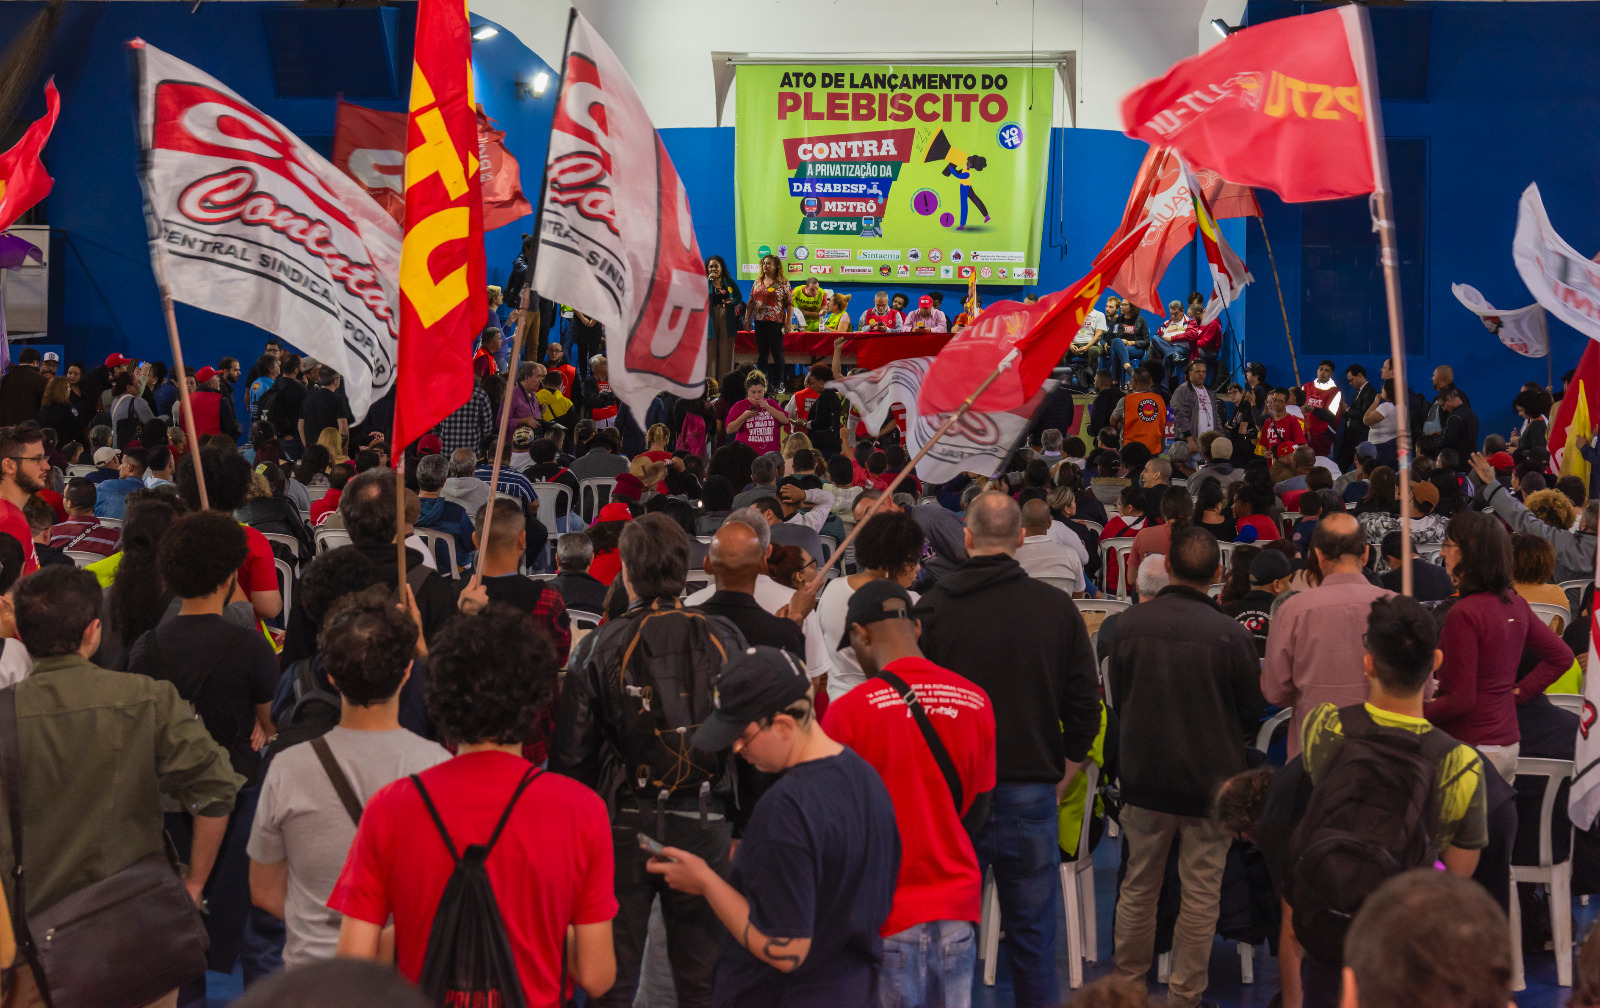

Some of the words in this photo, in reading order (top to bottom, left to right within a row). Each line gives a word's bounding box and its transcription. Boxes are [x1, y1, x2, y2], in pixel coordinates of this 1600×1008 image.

[780, 72, 817, 89] ATO
[821, 72, 845, 89] DE
[850, 73, 977, 92] LANÇAMENTO
[981, 74, 1008, 90] DO
[777, 91, 1009, 122] PLEBISCITO
[1001, 127, 1019, 140] VO
[1004, 135, 1021, 148] TE
[797, 138, 898, 160] CONTRA
[807, 164, 814, 176] A
[815, 163, 878, 178] PRIVATIZAÇÃO
[879, 165, 892, 177] DA
[793, 182, 812, 194] DA
[815, 183, 867, 194] SABESP
[824, 198, 877, 213] METRÔ
[809, 221, 818, 231] E
[820, 221, 857, 231] CPTM
[862, 250, 901, 260] Sintaema
[810, 265, 832, 274] CUT
[69, 533, 86, 548] adidas
